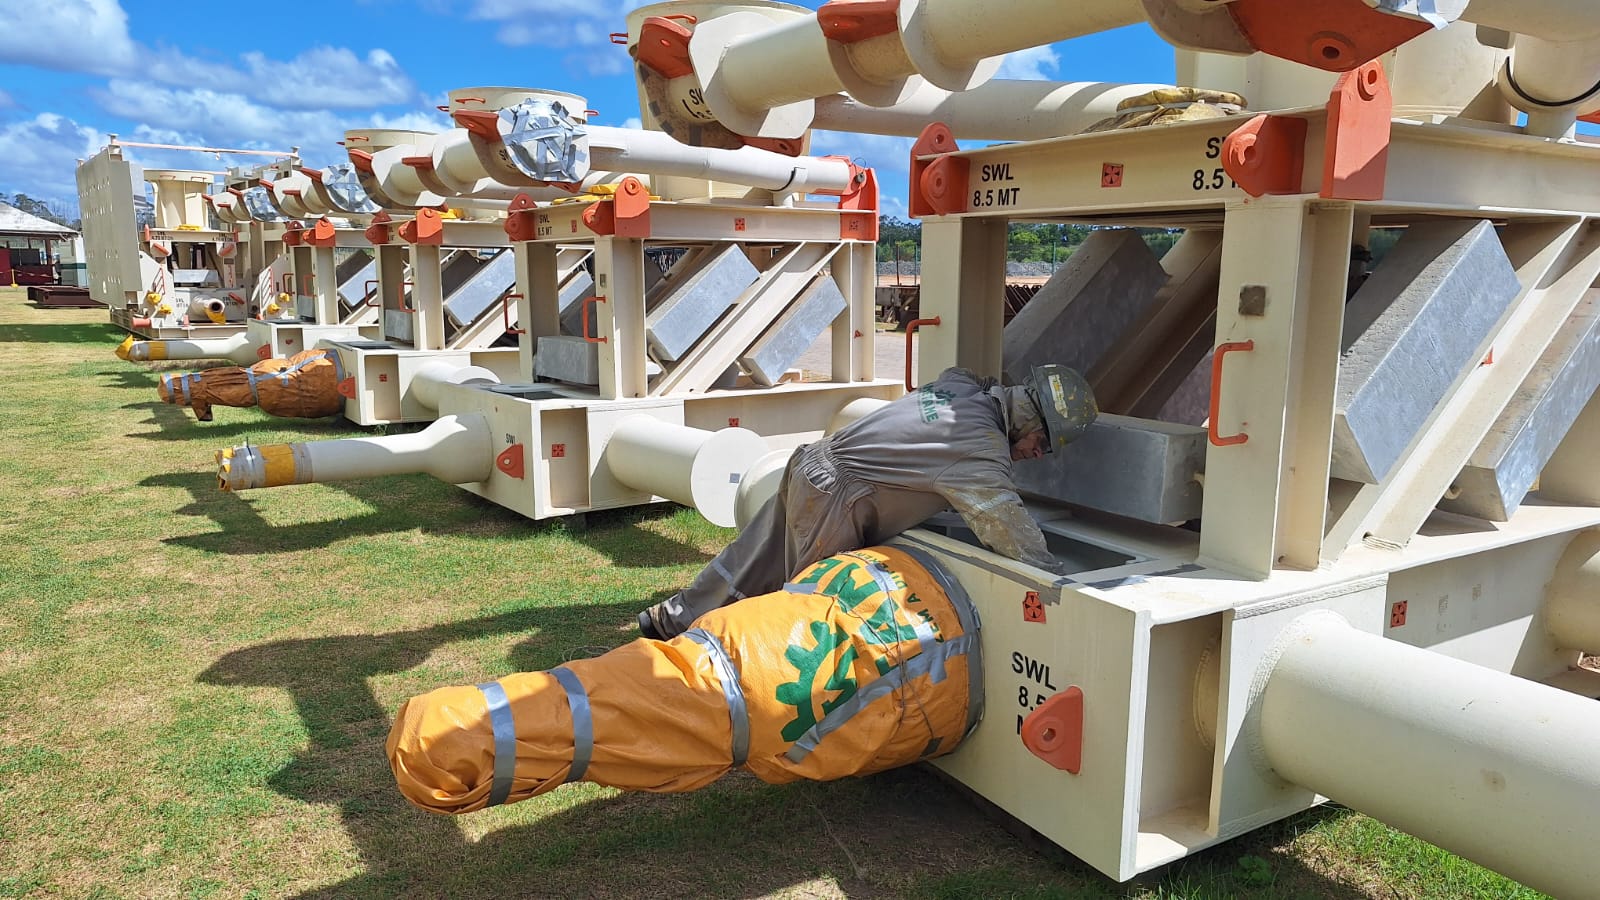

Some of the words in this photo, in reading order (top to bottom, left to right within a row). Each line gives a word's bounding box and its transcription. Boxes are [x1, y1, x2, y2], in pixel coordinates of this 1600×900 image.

[981, 163, 1014, 182] SWL
[1192, 168, 1225, 190] 8.5
[973, 190, 993, 207] 8.5
[998, 188, 1020, 206] MT
[1011, 651, 1057, 691] SWL
